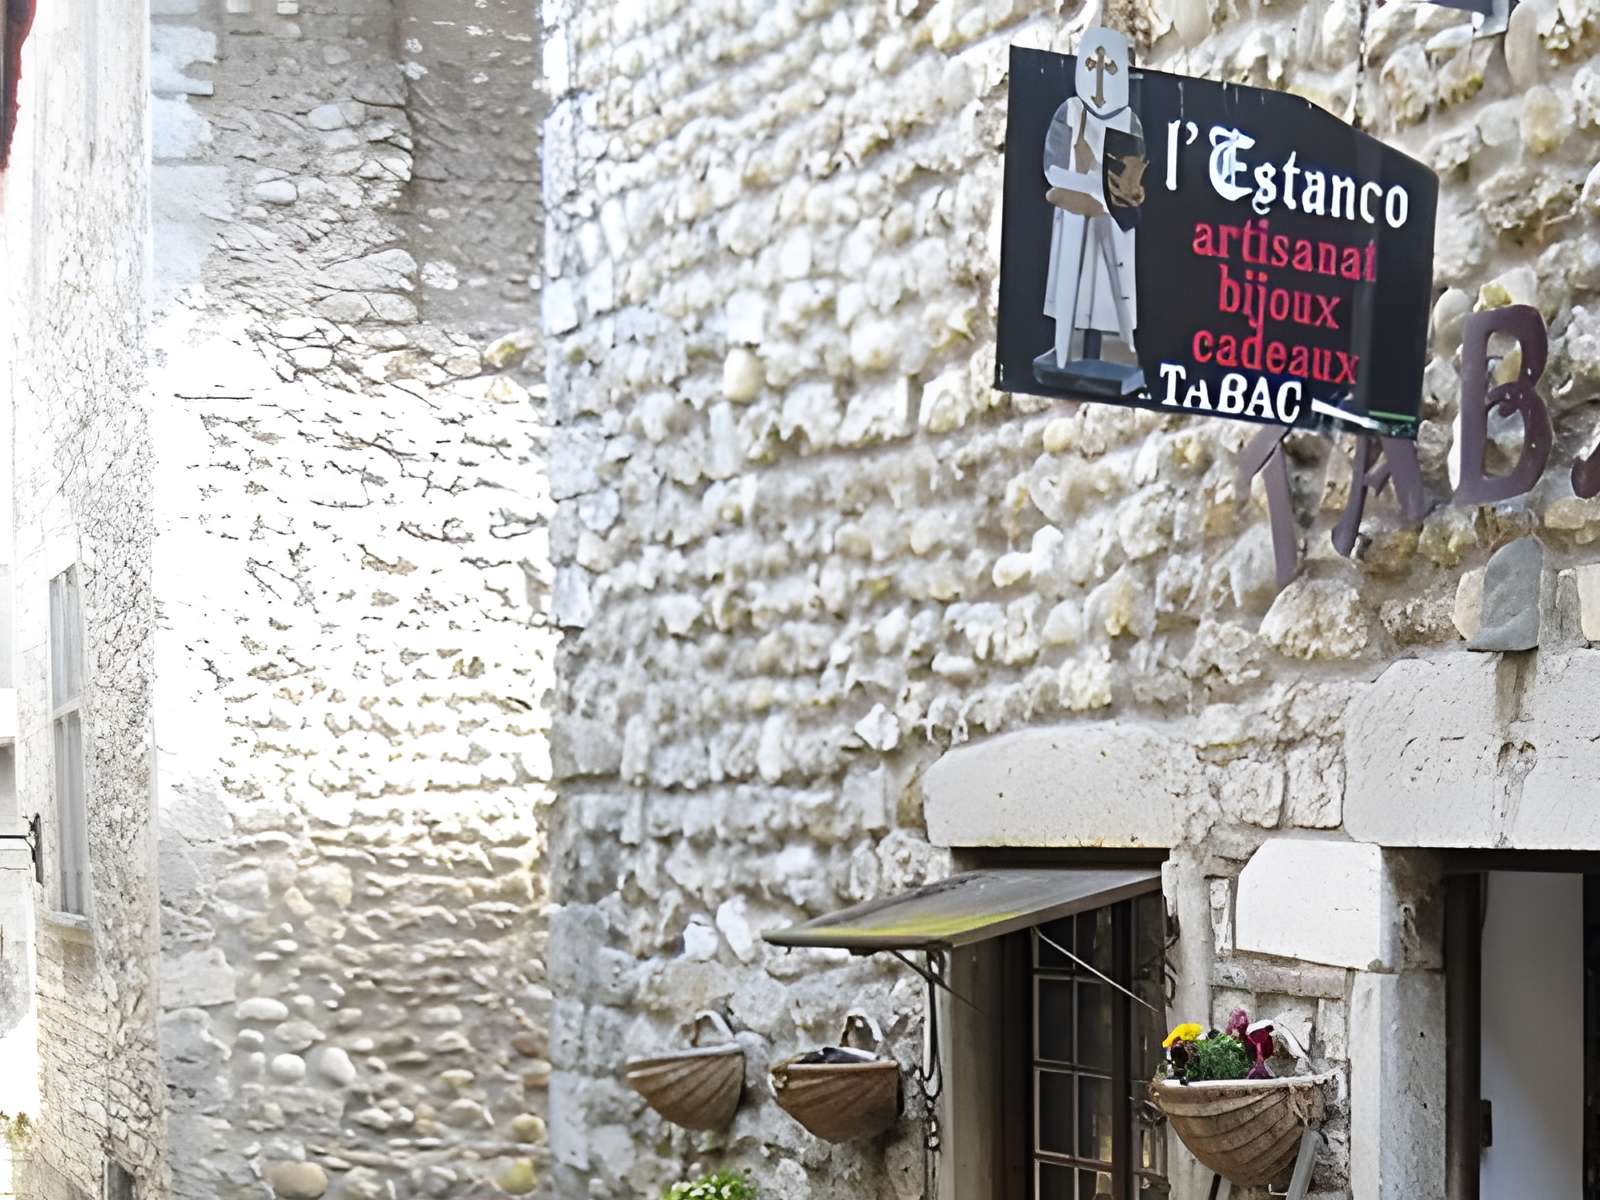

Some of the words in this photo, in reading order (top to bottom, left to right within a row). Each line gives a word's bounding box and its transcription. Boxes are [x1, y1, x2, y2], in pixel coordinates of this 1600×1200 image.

[1192, 218, 1377, 282] artisanat
[1218, 264, 1341, 328] bijoux
[1191, 324, 1360, 384] cadeaux
[1160, 362, 1302, 424] TABAC
